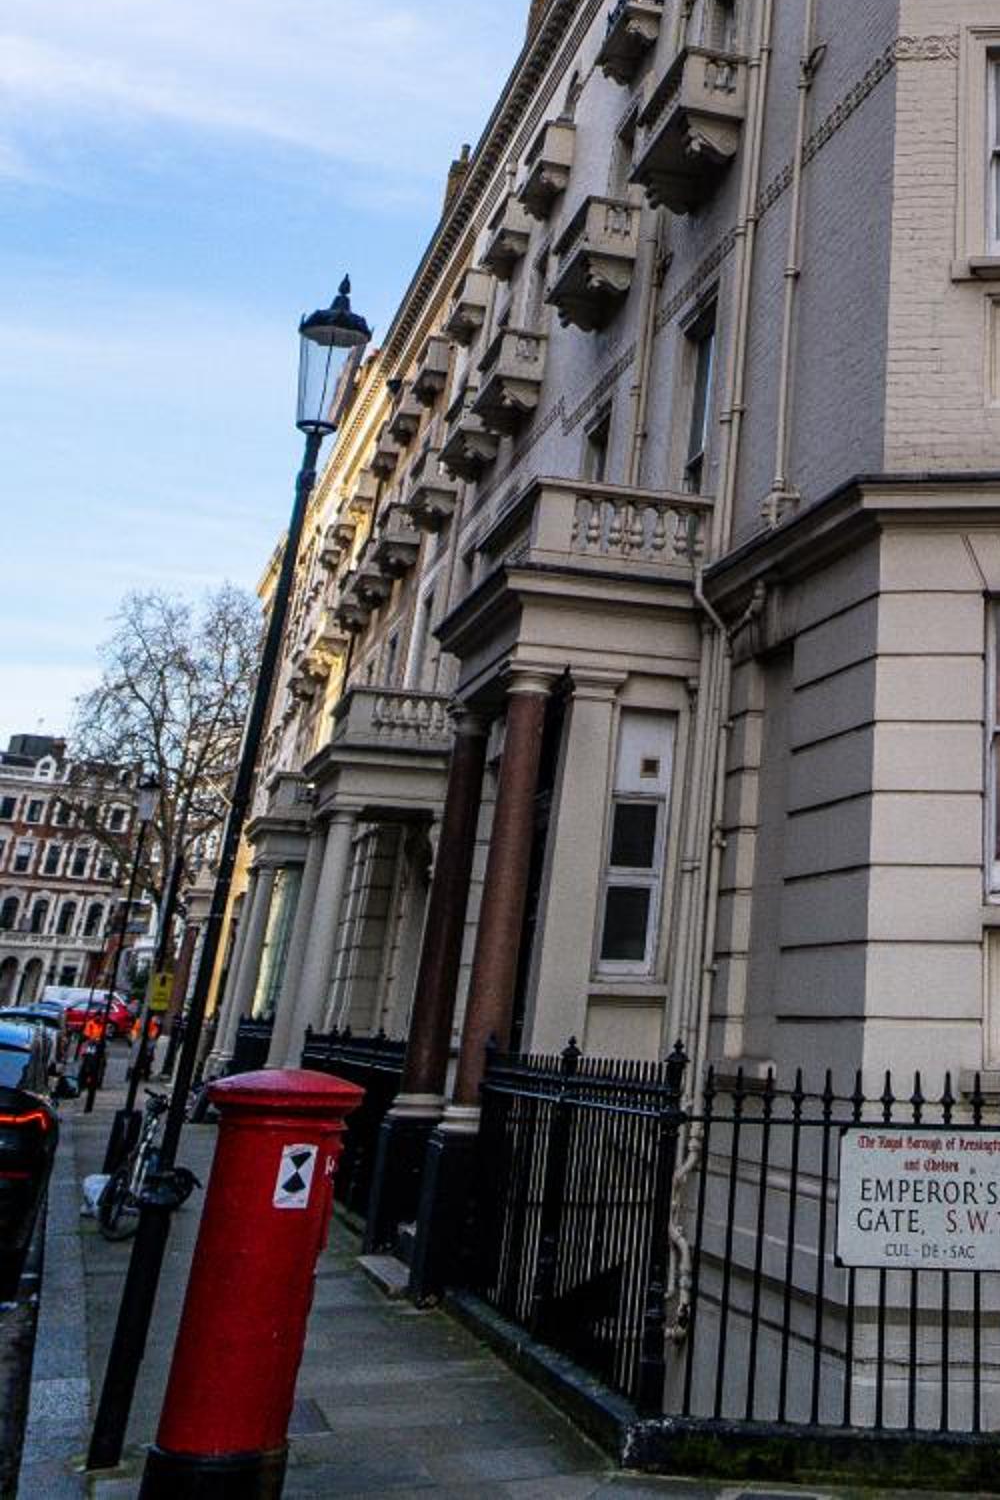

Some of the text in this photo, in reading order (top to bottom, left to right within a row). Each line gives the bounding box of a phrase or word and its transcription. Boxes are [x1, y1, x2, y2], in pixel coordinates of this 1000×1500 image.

[858, 1135, 875, 1149] The
[878, 1135, 903, 1152] Royal
[907, 1136, 942, 1154] Borough
[946, 1137, 956, 1150] of
[904, 1158, 959, 1172] and Chelsea
[861, 1179, 998, 1204] EMPEROR'S
[857, 1207, 925, 1235] GATE,
